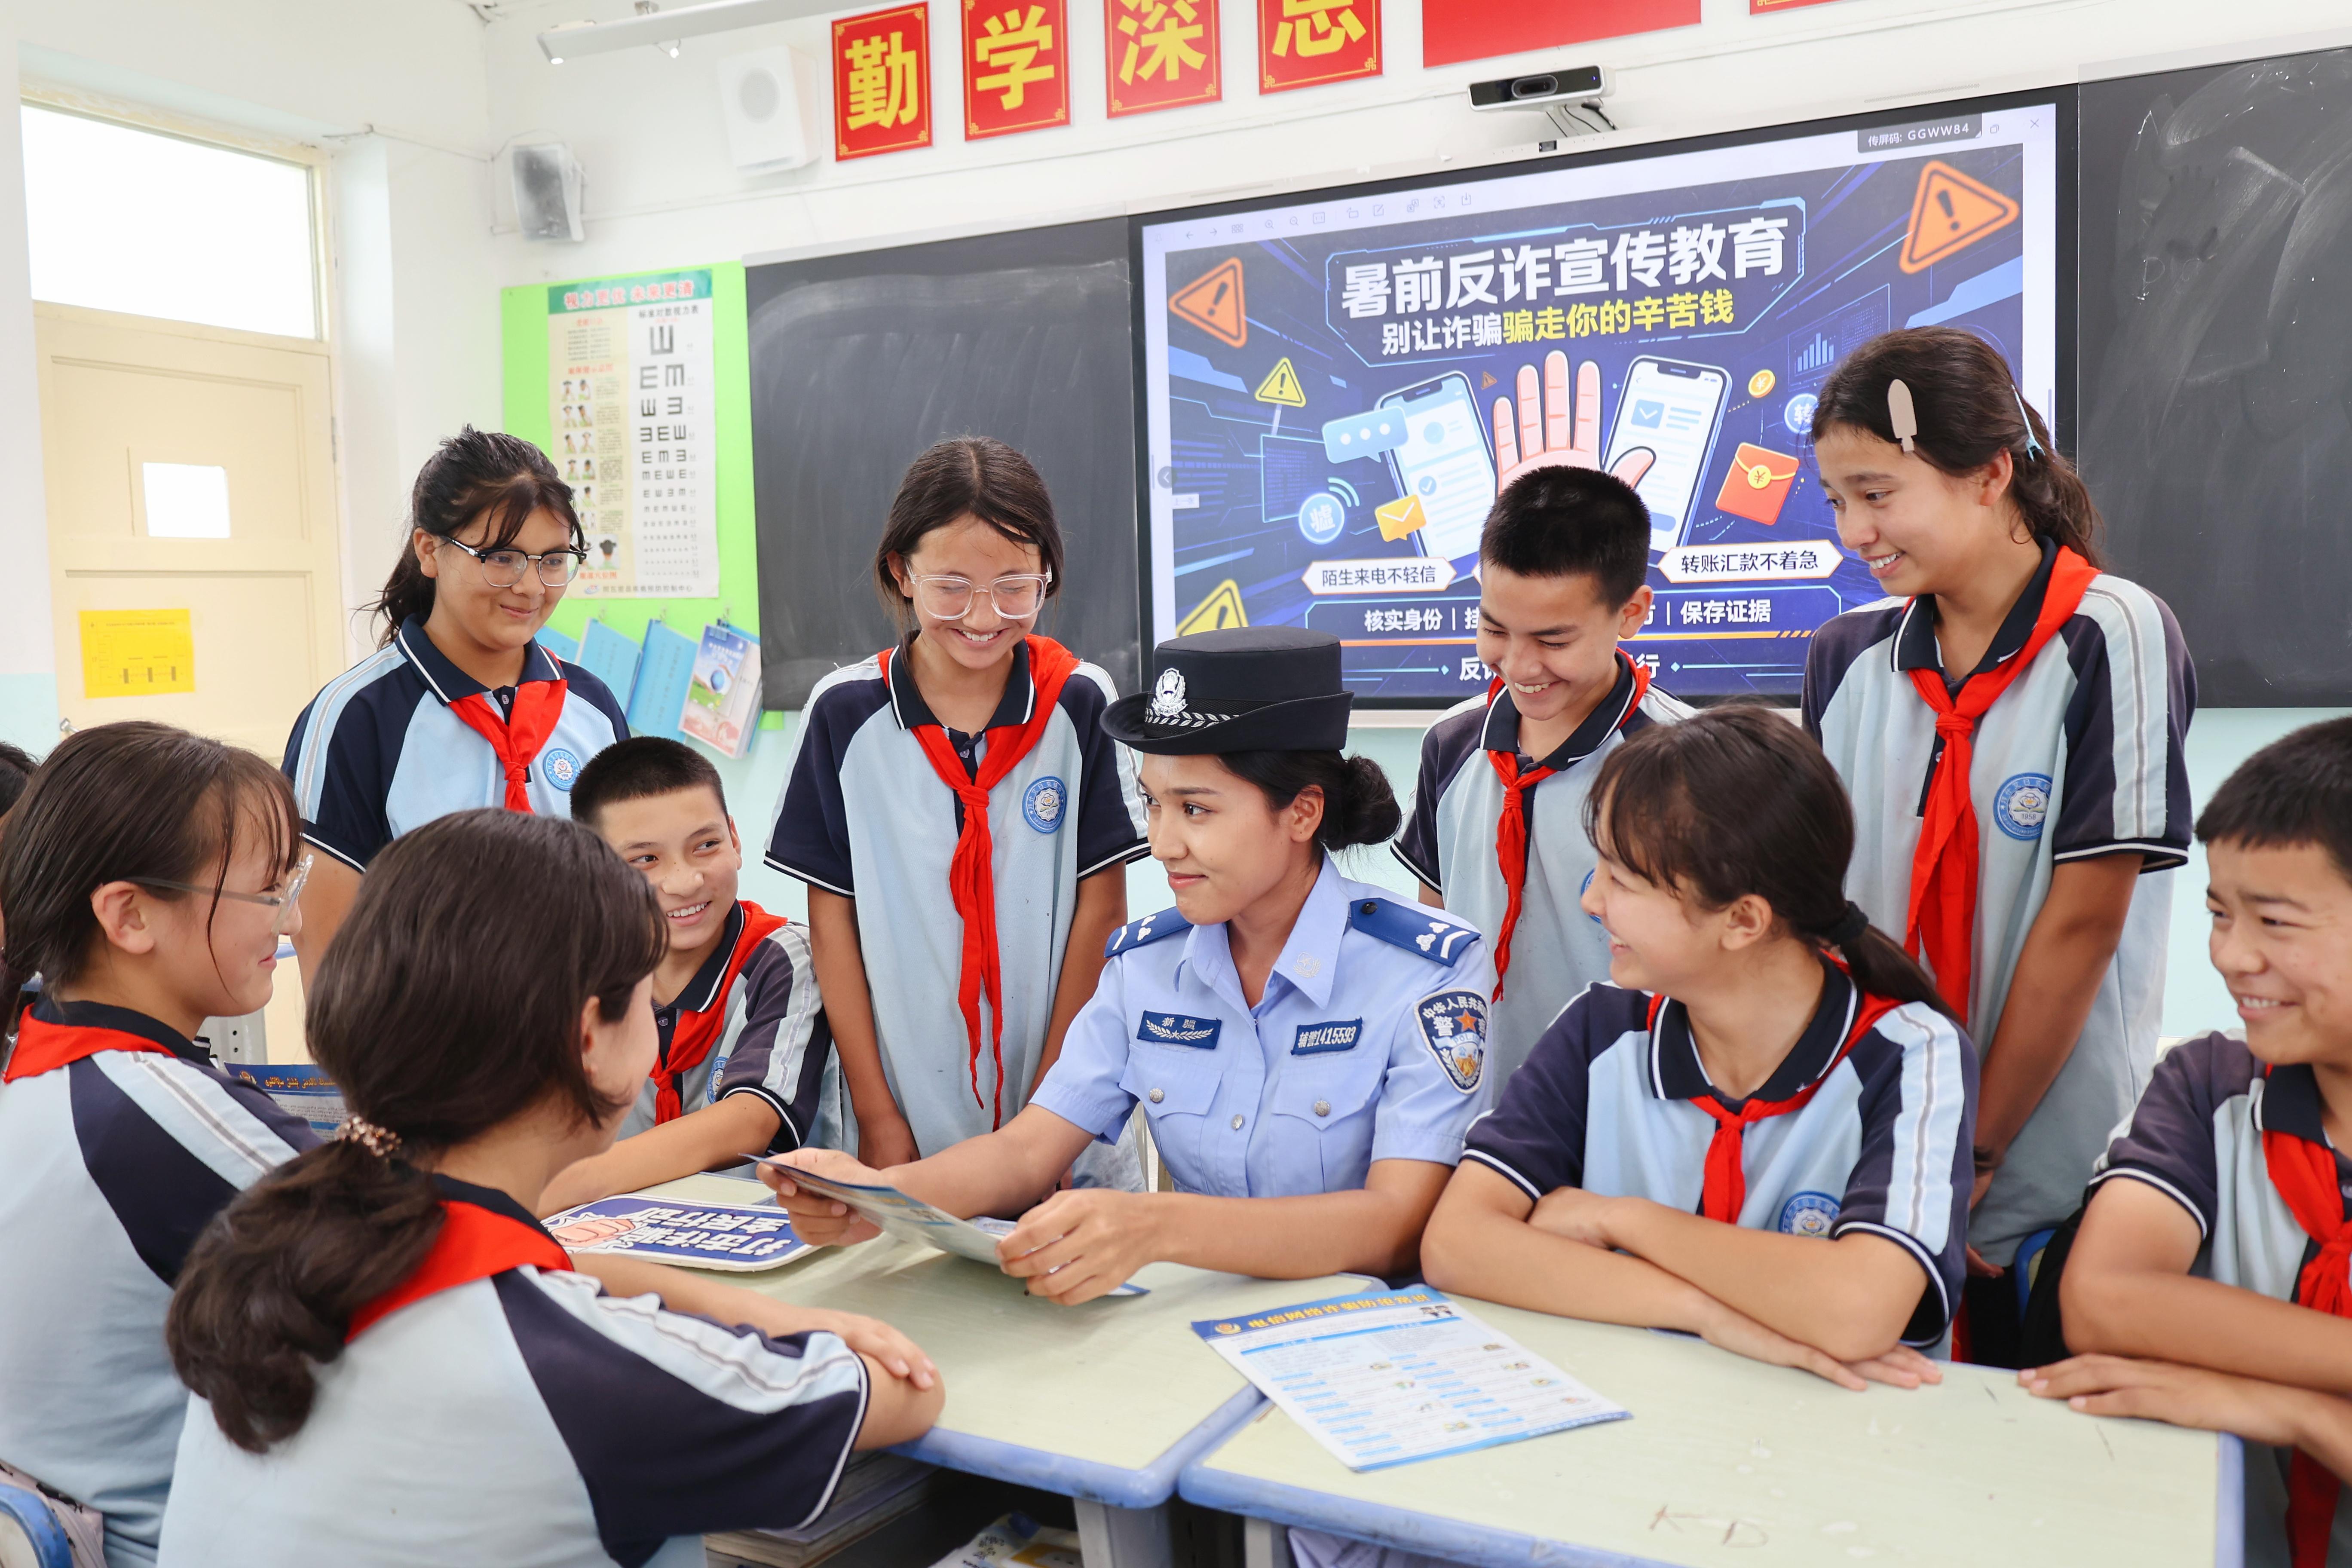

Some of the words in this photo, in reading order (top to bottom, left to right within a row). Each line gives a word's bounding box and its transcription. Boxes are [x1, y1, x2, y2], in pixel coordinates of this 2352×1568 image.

[975, 5, 1056, 110] 学
[845, 31, 918, 130] 勤
[1908, 122, 1969, 141] GGWW84
[1341, 217, 1789, 320] 暑前反诈宣传教育
[1381, 288, 1734, 356] 别让诈骗骗走你的辛苦钱
[1322, 566, 1436, 587] 陌生来电不轻信
[1681, 550, 1819, 573] 转账汇款不着急
[1364, 607, 1442, 632] 核实身份
[1680, 599, 1771, 625] 保存证据
[1162, 1017, 1196, 1030] 新疆
[620, 1225, 792, 1256] 打击诈骗
[1248, 1293, 1431, 1329] 电信网络诈骗防范常识
